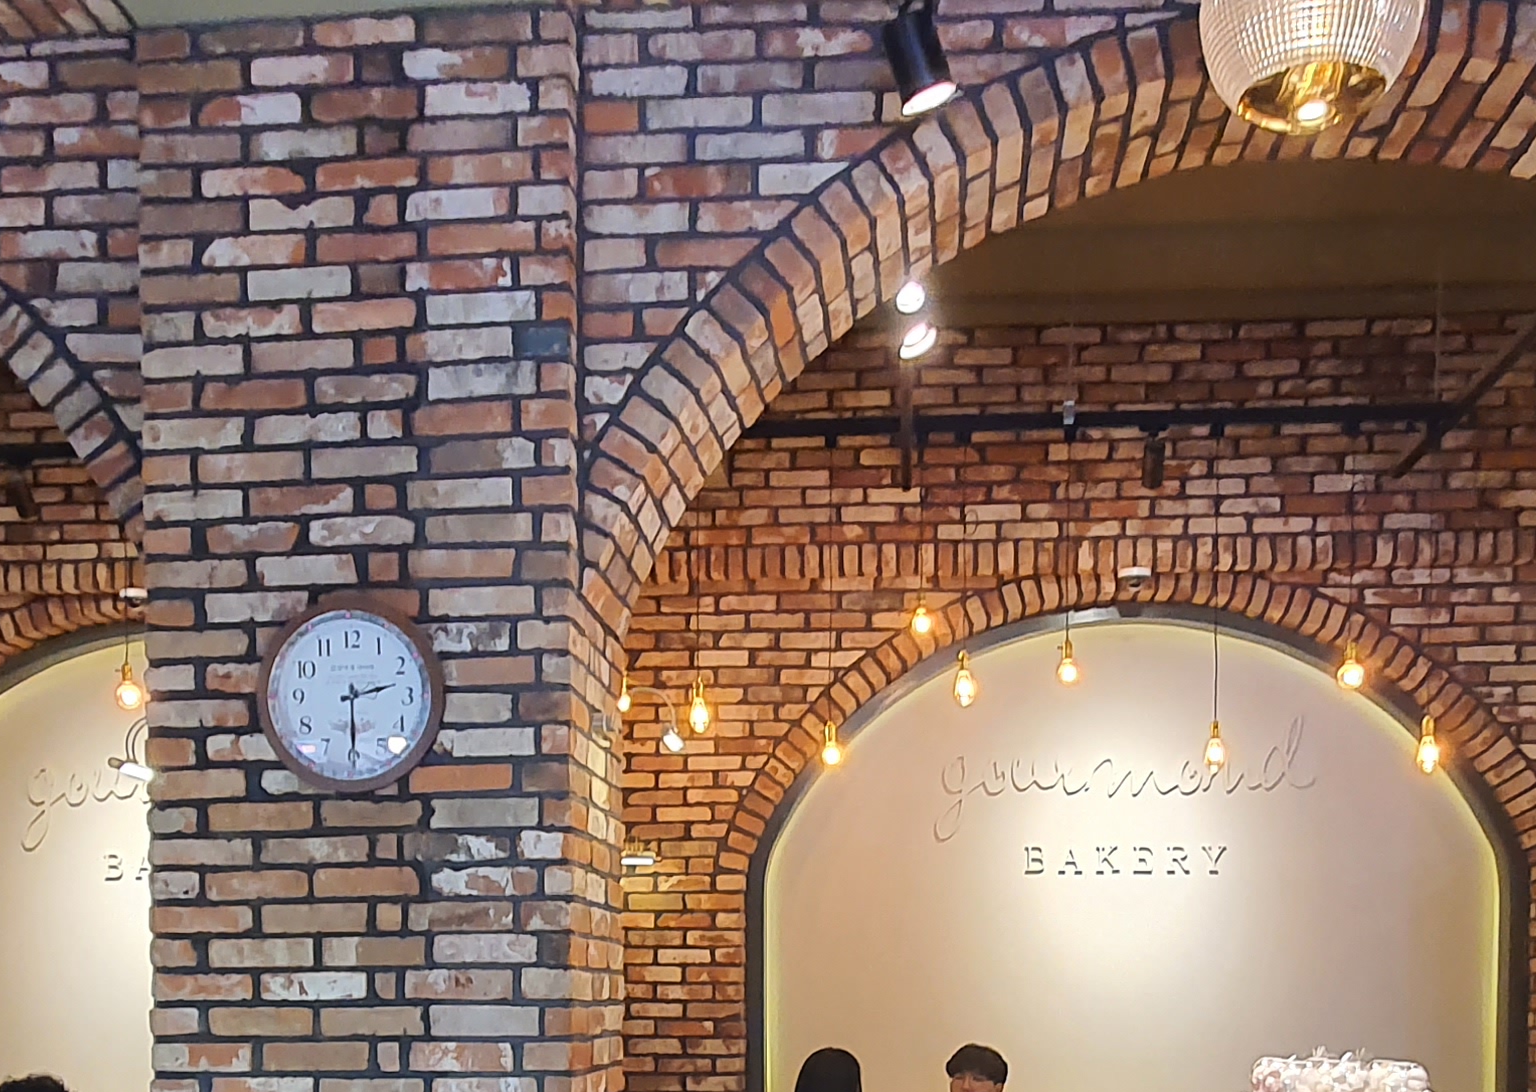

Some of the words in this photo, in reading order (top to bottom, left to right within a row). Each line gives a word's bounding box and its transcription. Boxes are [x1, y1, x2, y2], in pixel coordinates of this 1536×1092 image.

[317, 638, 331, 657] 11
[344, 630, 361, 649] 12
[297, 660, 316, 680] 10
[395, 656, 406, 676] 2
[292, 688, 305, 705] 9
[401, 687, 414, 706] 3
[299, 715, 312, 735] 8
[393, 714, 405, 733] 4
[321, 737, 330, 756] 7
[375, 737, 388, 756] 5
[1023, 845, 1228, 876] BAKERY
